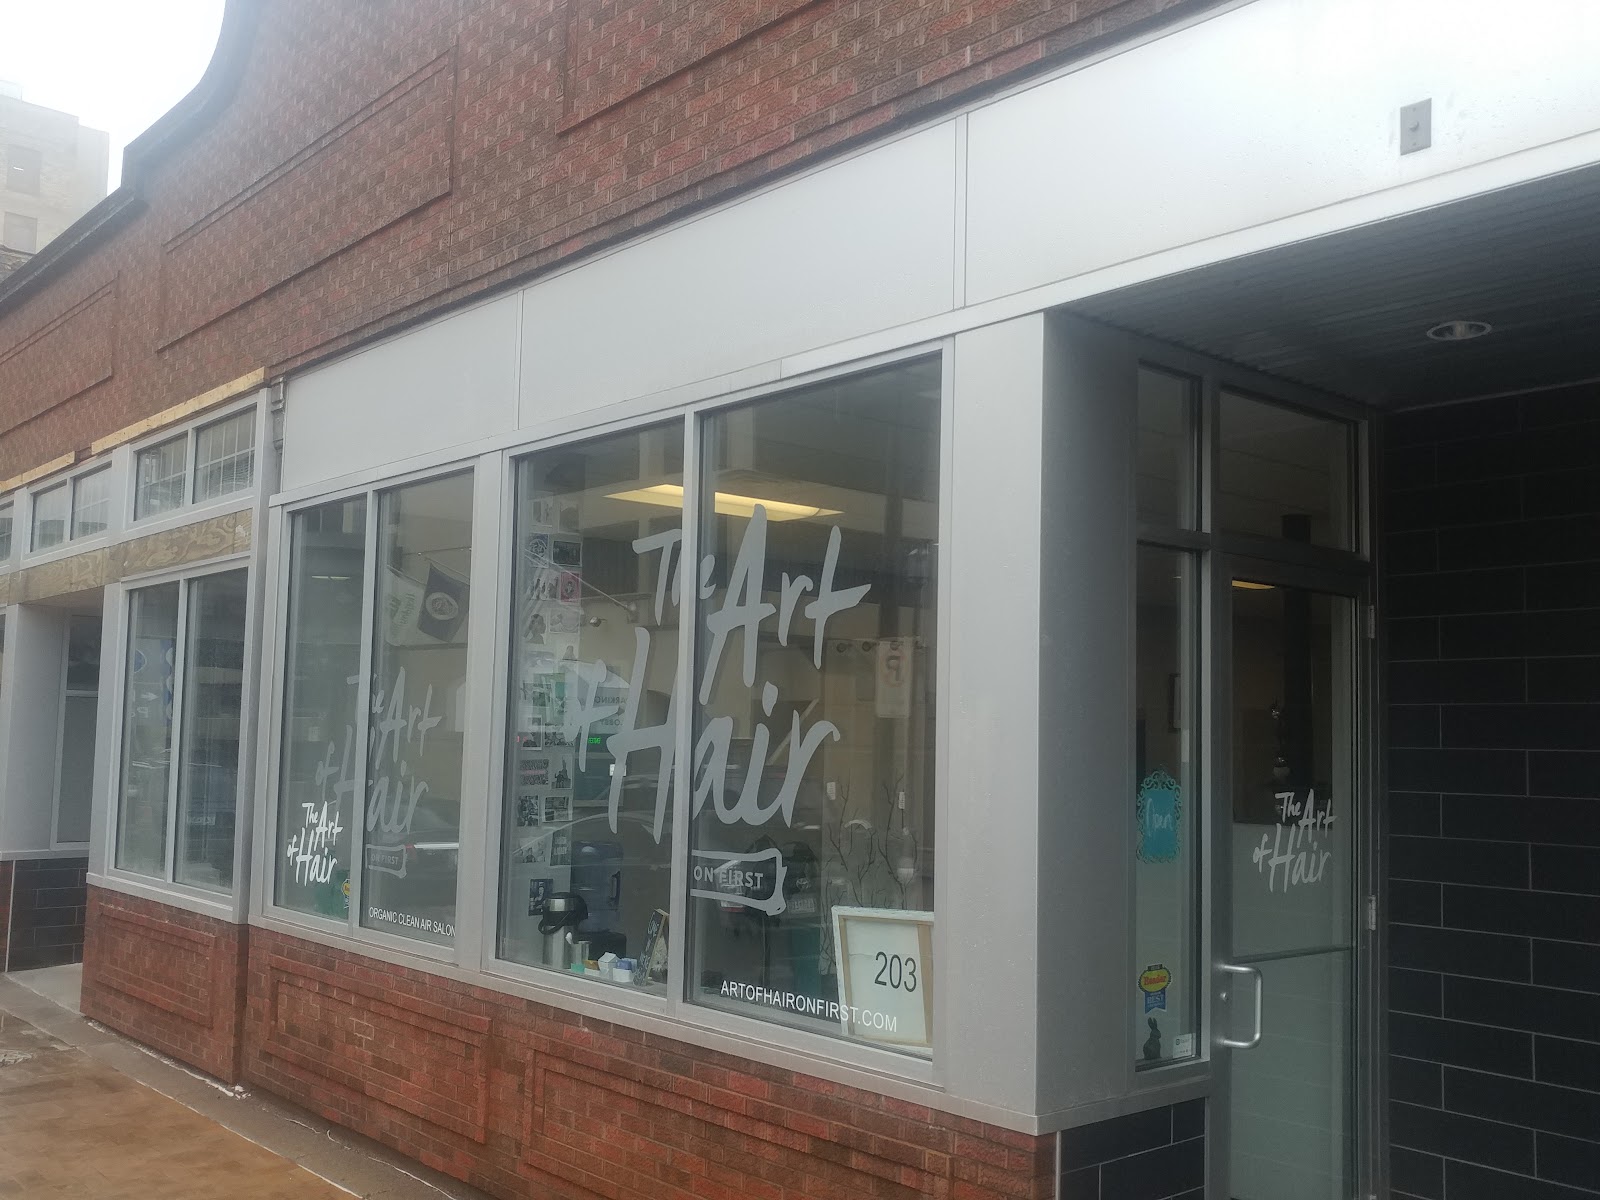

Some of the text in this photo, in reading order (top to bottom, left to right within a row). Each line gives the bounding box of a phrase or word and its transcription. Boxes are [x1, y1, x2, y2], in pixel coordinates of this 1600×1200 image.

[699, 503, 872, 706] Art
[375, 666, 443, 770] Art
[606, 626, 841, 845] Hair
[302, 800, 343, 851] The Art
[1275, 788, 1338, 848] The Art
[287, 827, 338, 887] of Hair
[693, 865, 764, 889] ON FIRST
[1252, 823, 1332, 893] of Hair
[369, 906, 456, 937] ORGANIC CLEAN AIR SALON
[874, 951, 917, 993] 203
[721, 979, 898, 1033] ARTOFHAIRONFIRST.COM
